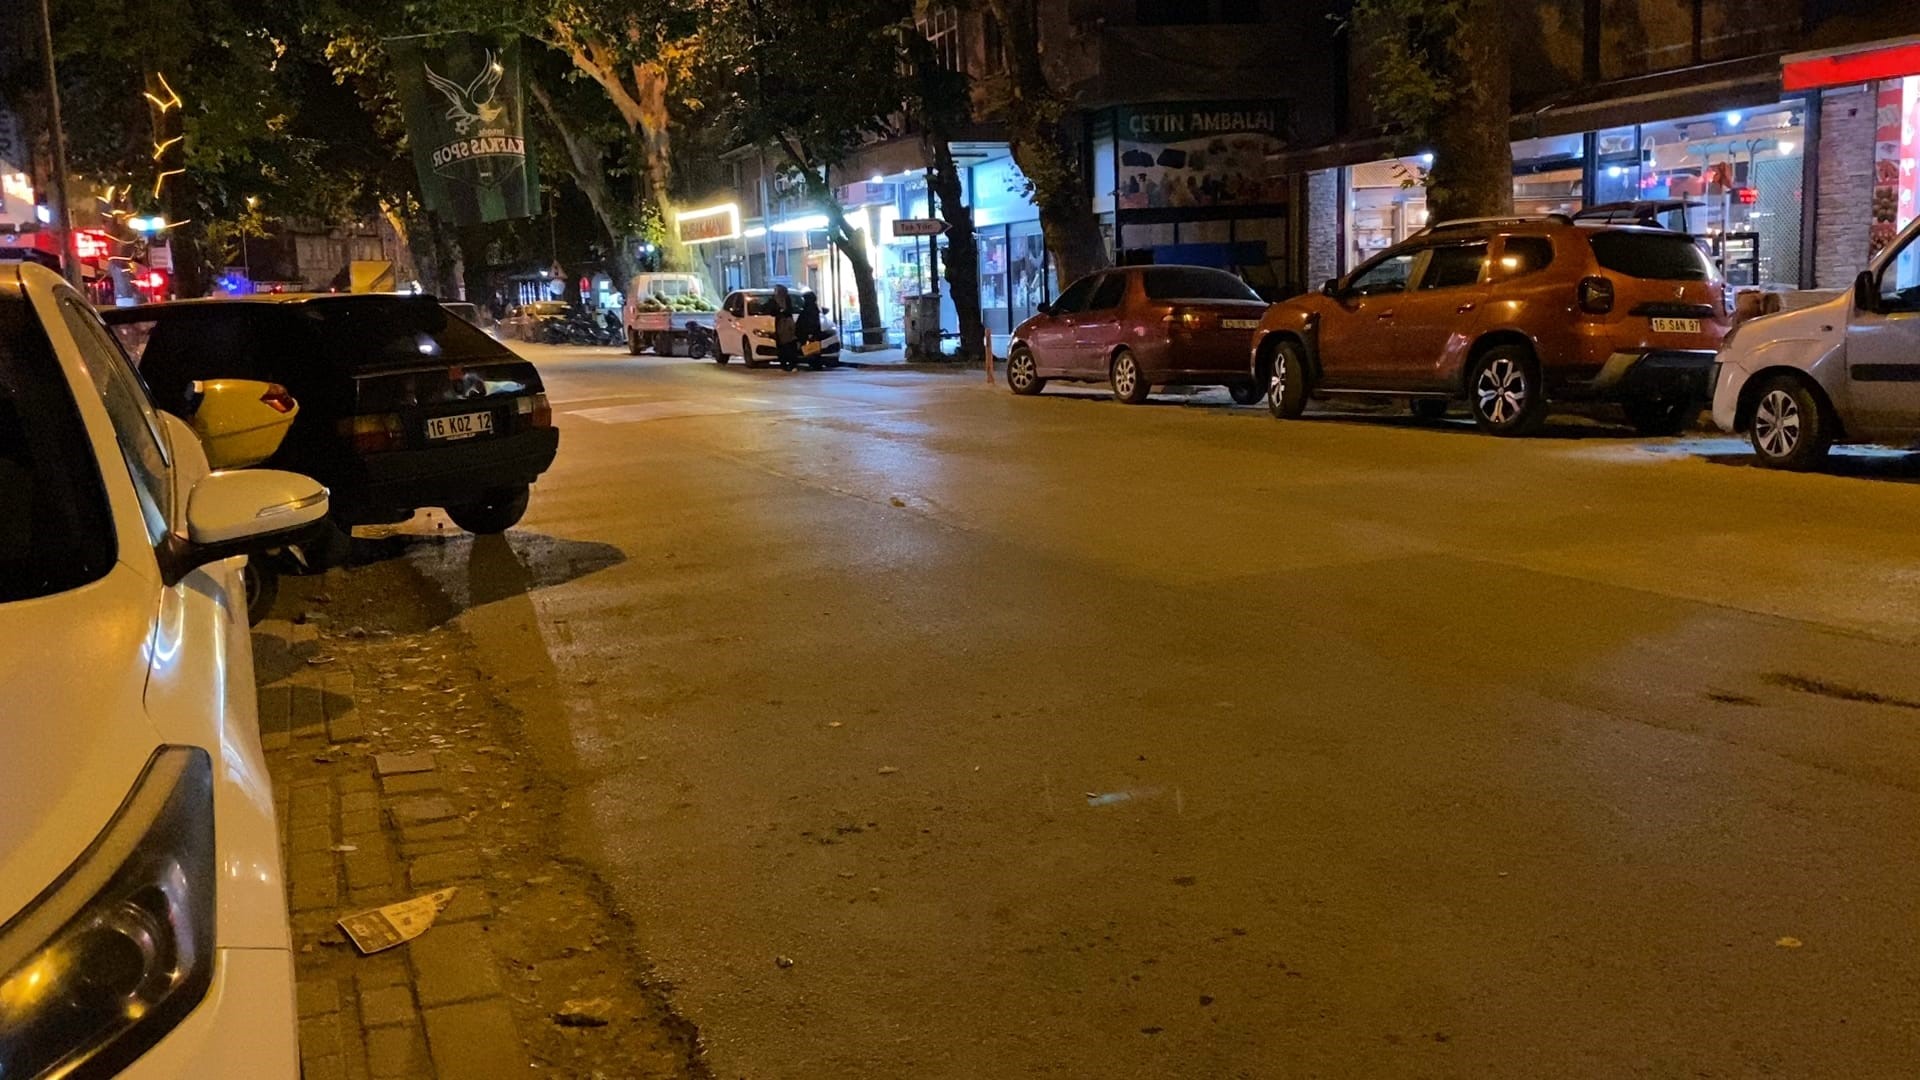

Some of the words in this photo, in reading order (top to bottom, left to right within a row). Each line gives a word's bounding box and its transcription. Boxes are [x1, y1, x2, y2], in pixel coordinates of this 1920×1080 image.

[430, 420, 445, 437] 16
[449, 415, 472, 434] KOZ
[477, 413, 491, 430] 12
